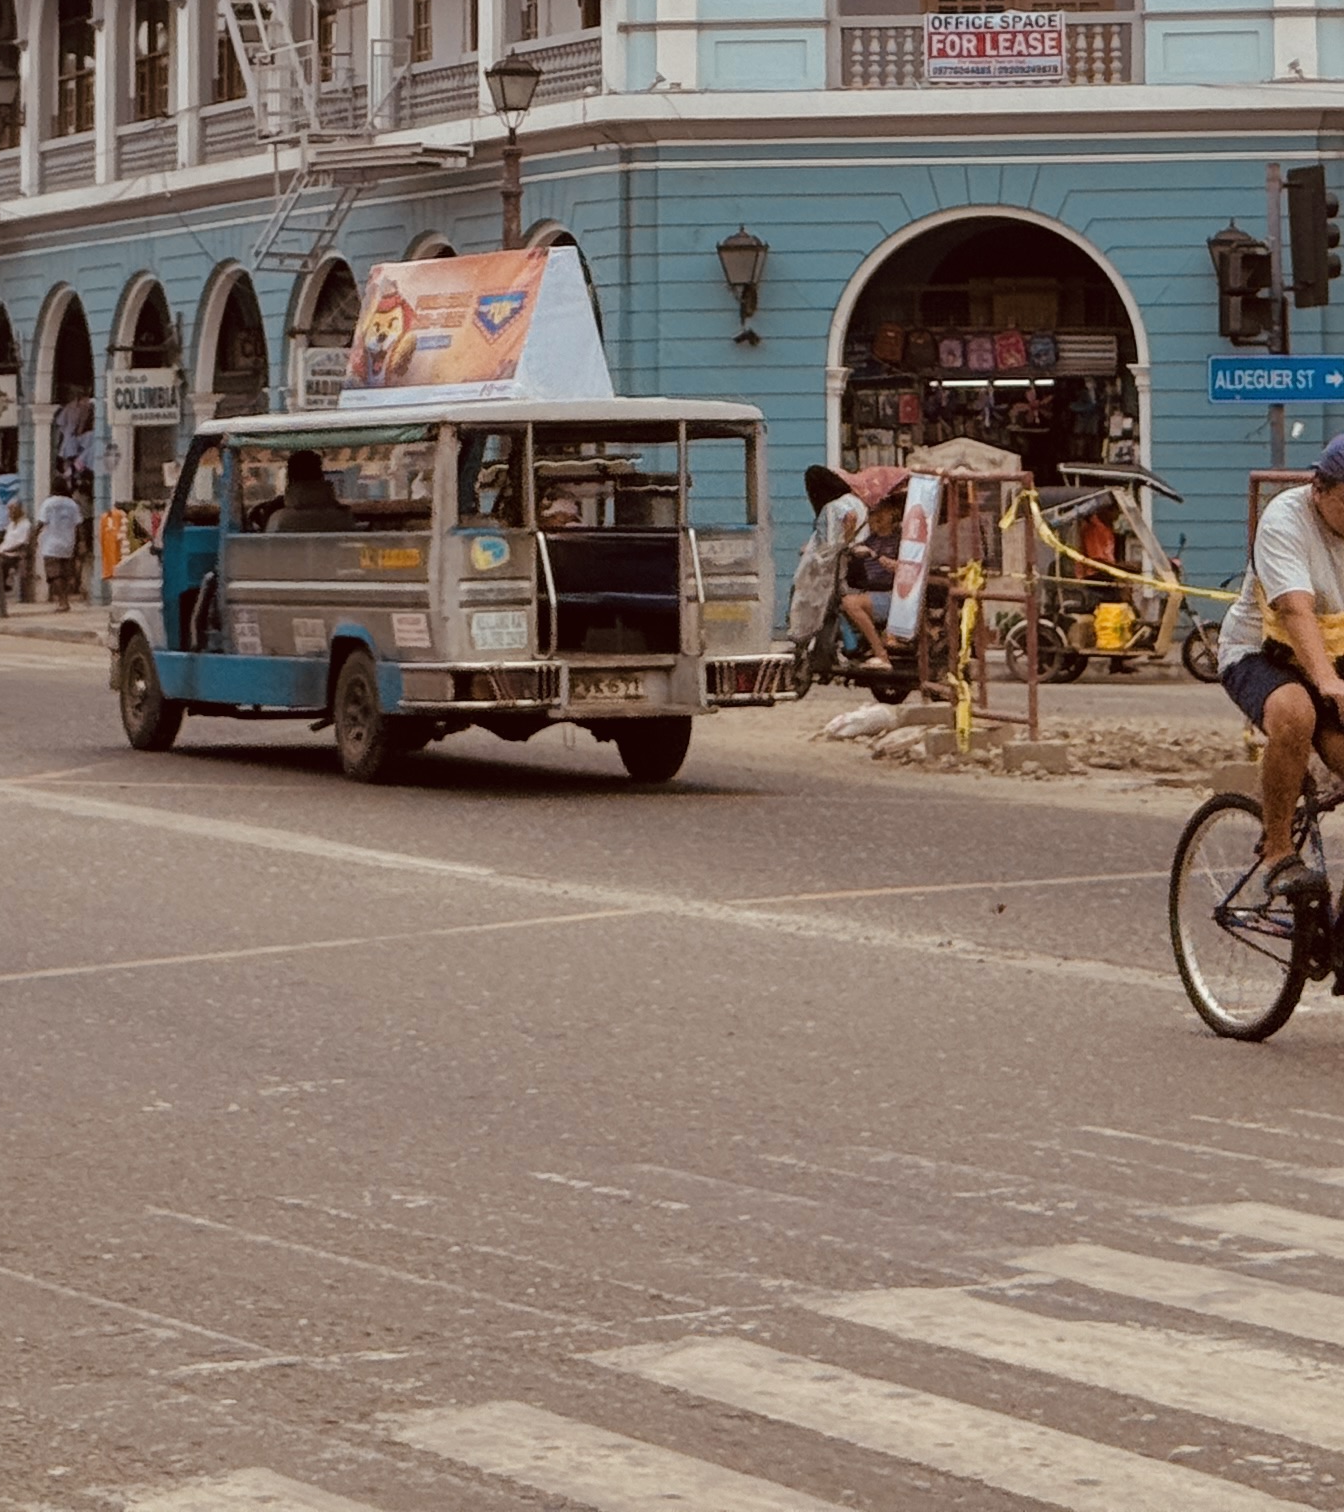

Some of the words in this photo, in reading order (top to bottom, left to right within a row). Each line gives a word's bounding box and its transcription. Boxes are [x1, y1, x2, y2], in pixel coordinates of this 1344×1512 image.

[931, 15, 994, 30] OFFICE
[999, 14, 1058, 29] SPACE
[930, 33, 978, 57] FOR
[984, 31, 1059, 56] LEASE
[1215, 369, 1294, 390] ALDEGUER
[1296, 369, 1316, 389] ST
[114, 384, 178, 410] COLUMBIA
